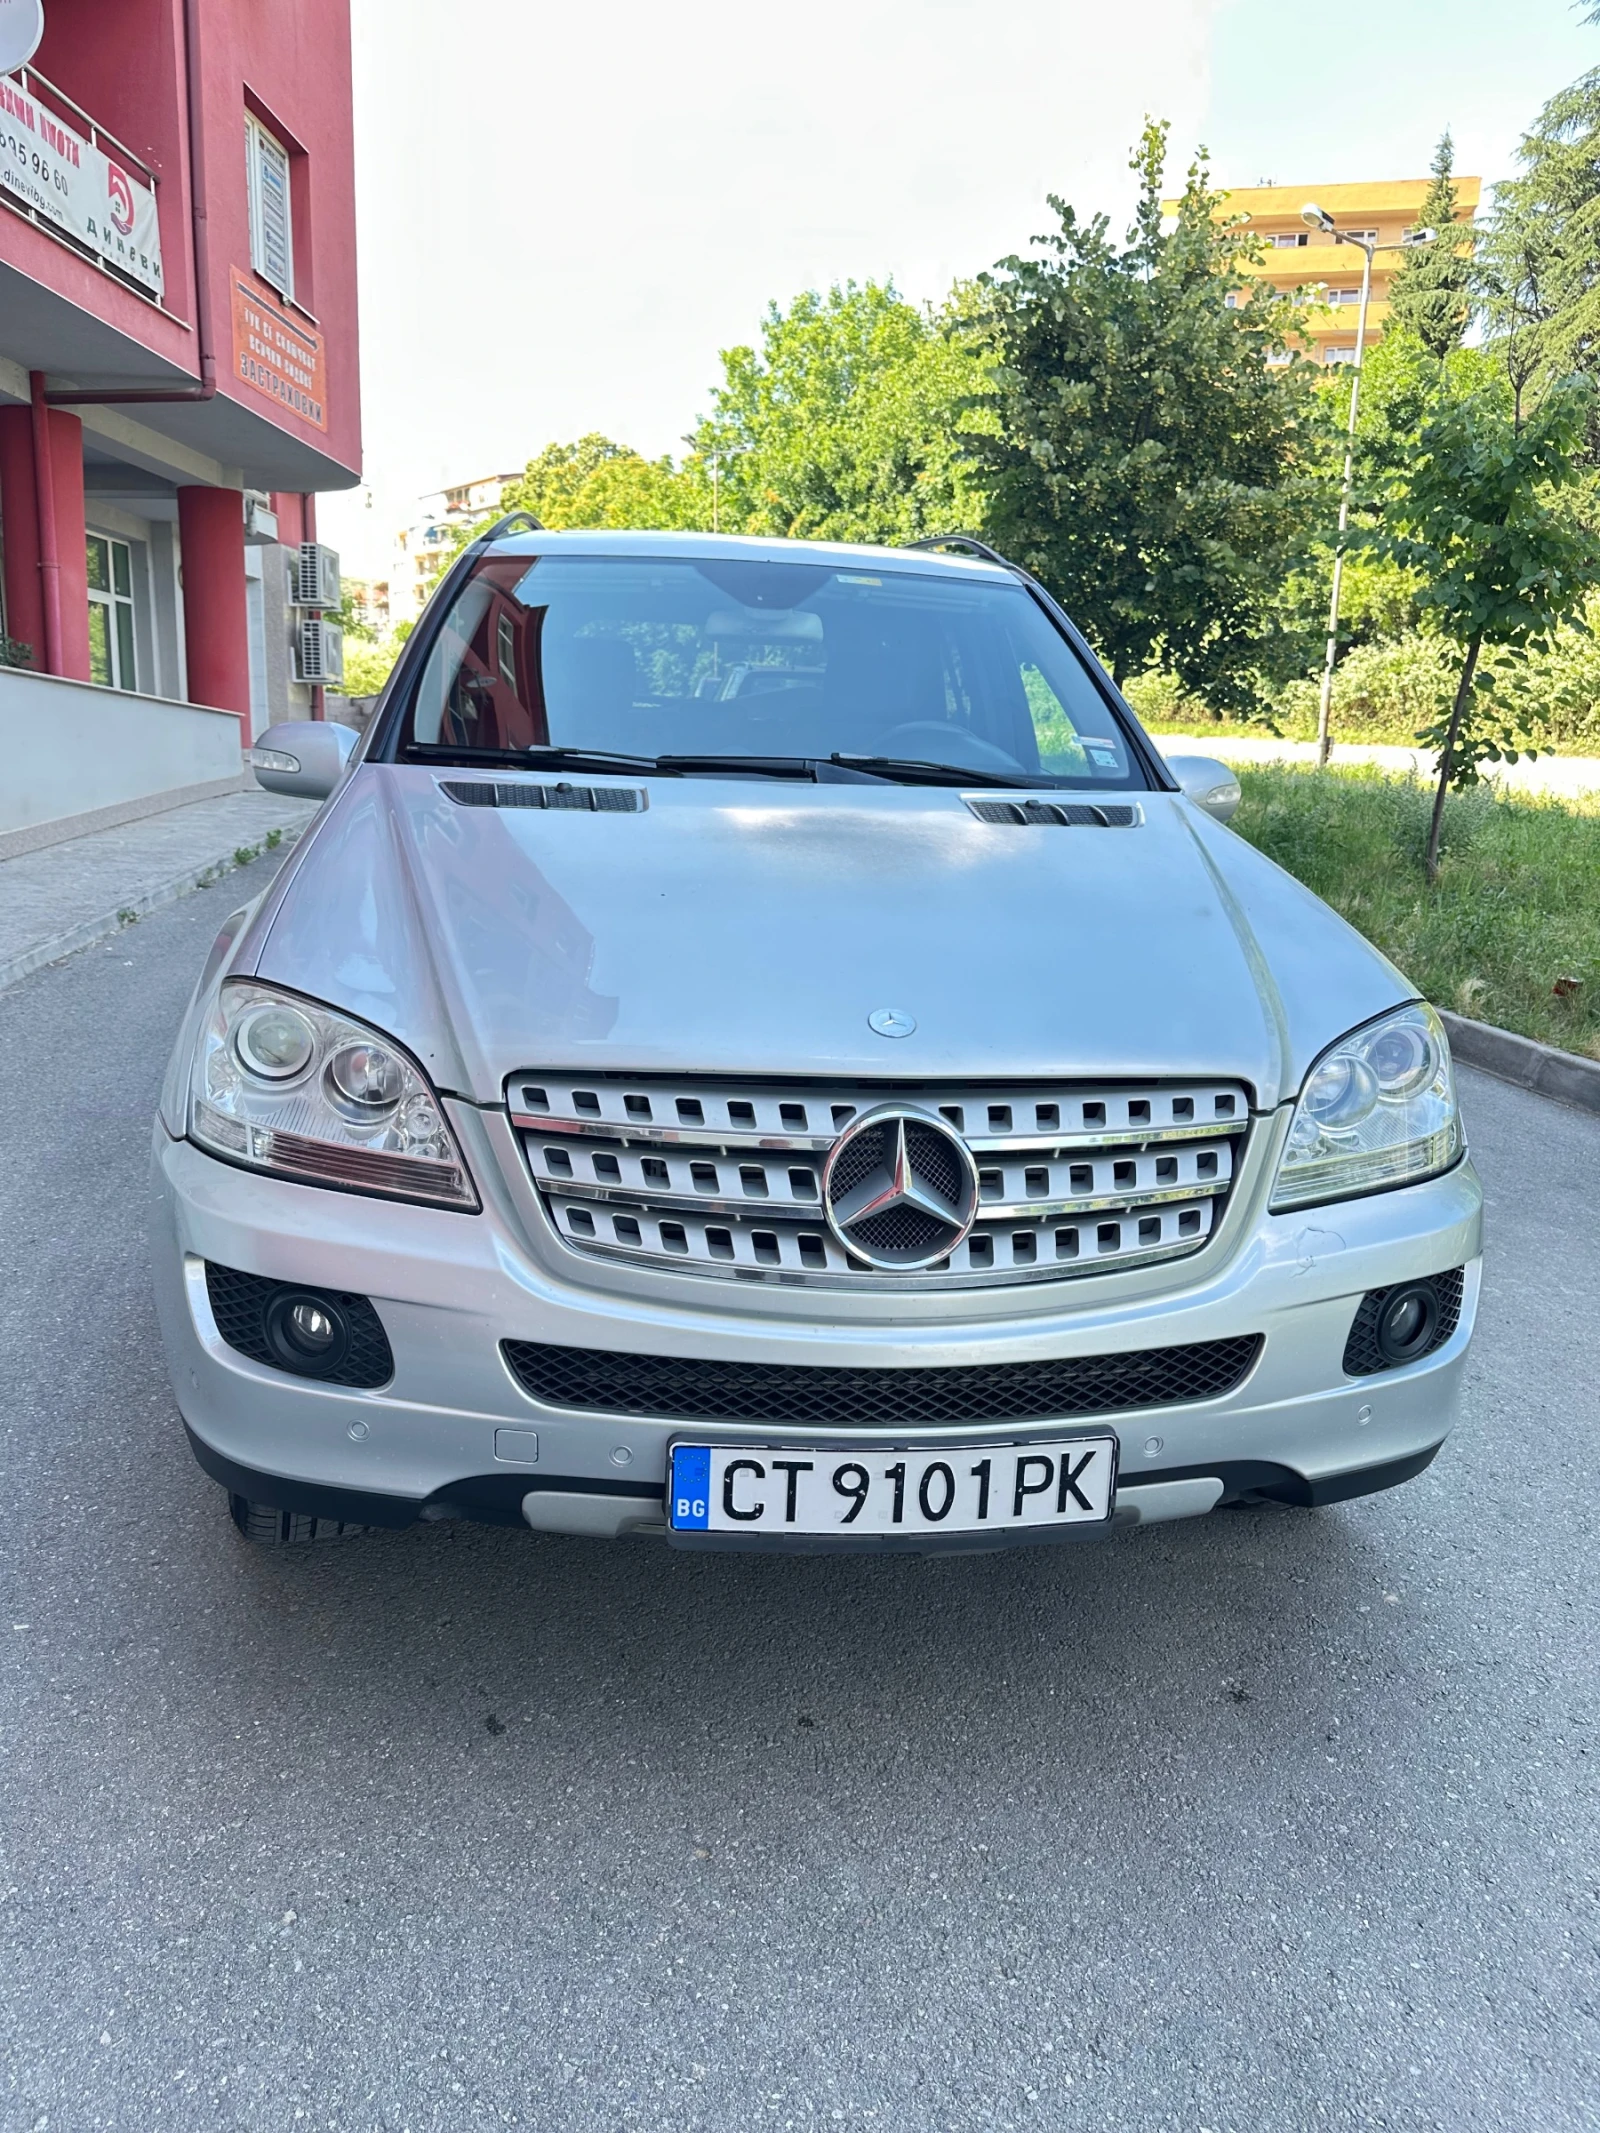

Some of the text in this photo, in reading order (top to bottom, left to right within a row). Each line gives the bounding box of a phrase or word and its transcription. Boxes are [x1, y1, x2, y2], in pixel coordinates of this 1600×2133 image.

[40, 112, 80, 169] ИМОТИ
[32, 152, 50, 182] 96
[54, 168, 69, 197] 60
[244, 307, 261, 332] ТУК
[249, 334, 282, 369] ВСИЧКИ
[240, 352, 323, 425] ЗАСТРАХОВКИ
[677, 1499, 705, 1517] BG
[722, 1450, 1097, 1524] CT 9101 PK
